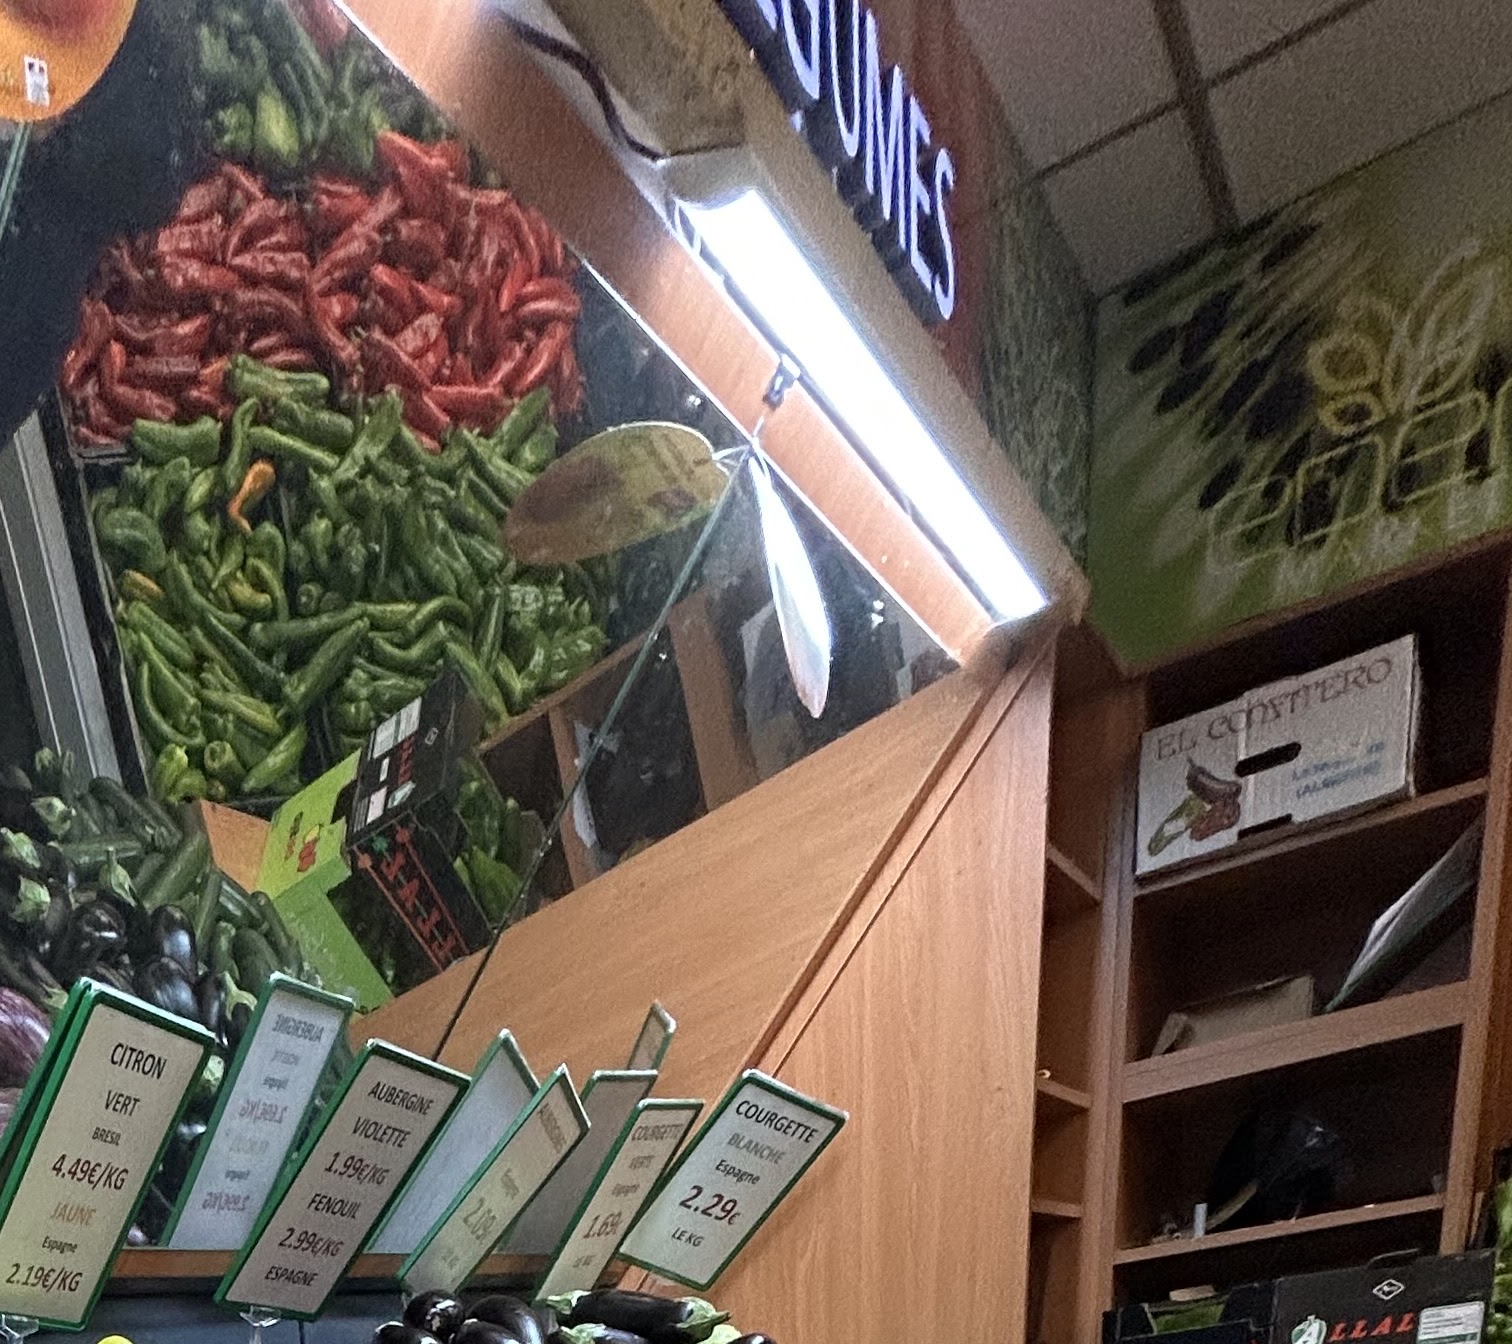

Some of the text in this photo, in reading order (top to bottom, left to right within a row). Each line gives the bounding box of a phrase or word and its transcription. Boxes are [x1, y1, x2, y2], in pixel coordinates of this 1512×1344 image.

[755, 0, 956, 320] UMES
[110, 1042, 168, 1080] CITRON
[104, 1089, 141, 1118] VERT
[368, 1080, 435, 1116] AUBERGINE
[92, 1126, 122, 1147] BRESIL
[351, 1115, 412, 1150] VIOLETTE
[735, 1099, 820, 1144] COURGETTE
[727, 1132, 785, 1165] BLANCHE
[51, 1153, 130, 1192] 4.49€/KG
[324, 1151, 391, 1187] 1.99€/KG
[715, 1158, 761, 1186] Espagne
[50, 1201, 97, 1228] JAUNE
[307, 1192, 361, 1221] FENOUIL
[678, 1184, 742, 1226] 2.29€
[41, 1235, 78, 1255] Espagne
[277, 1226, 345, 1258] 2.99€/KG
[671, 1227, 704, 1247] LE KG
[5, 1262, 83, 1294] 2.19€/KG
[264, 1264, 319, 1288] ESPAGNE
